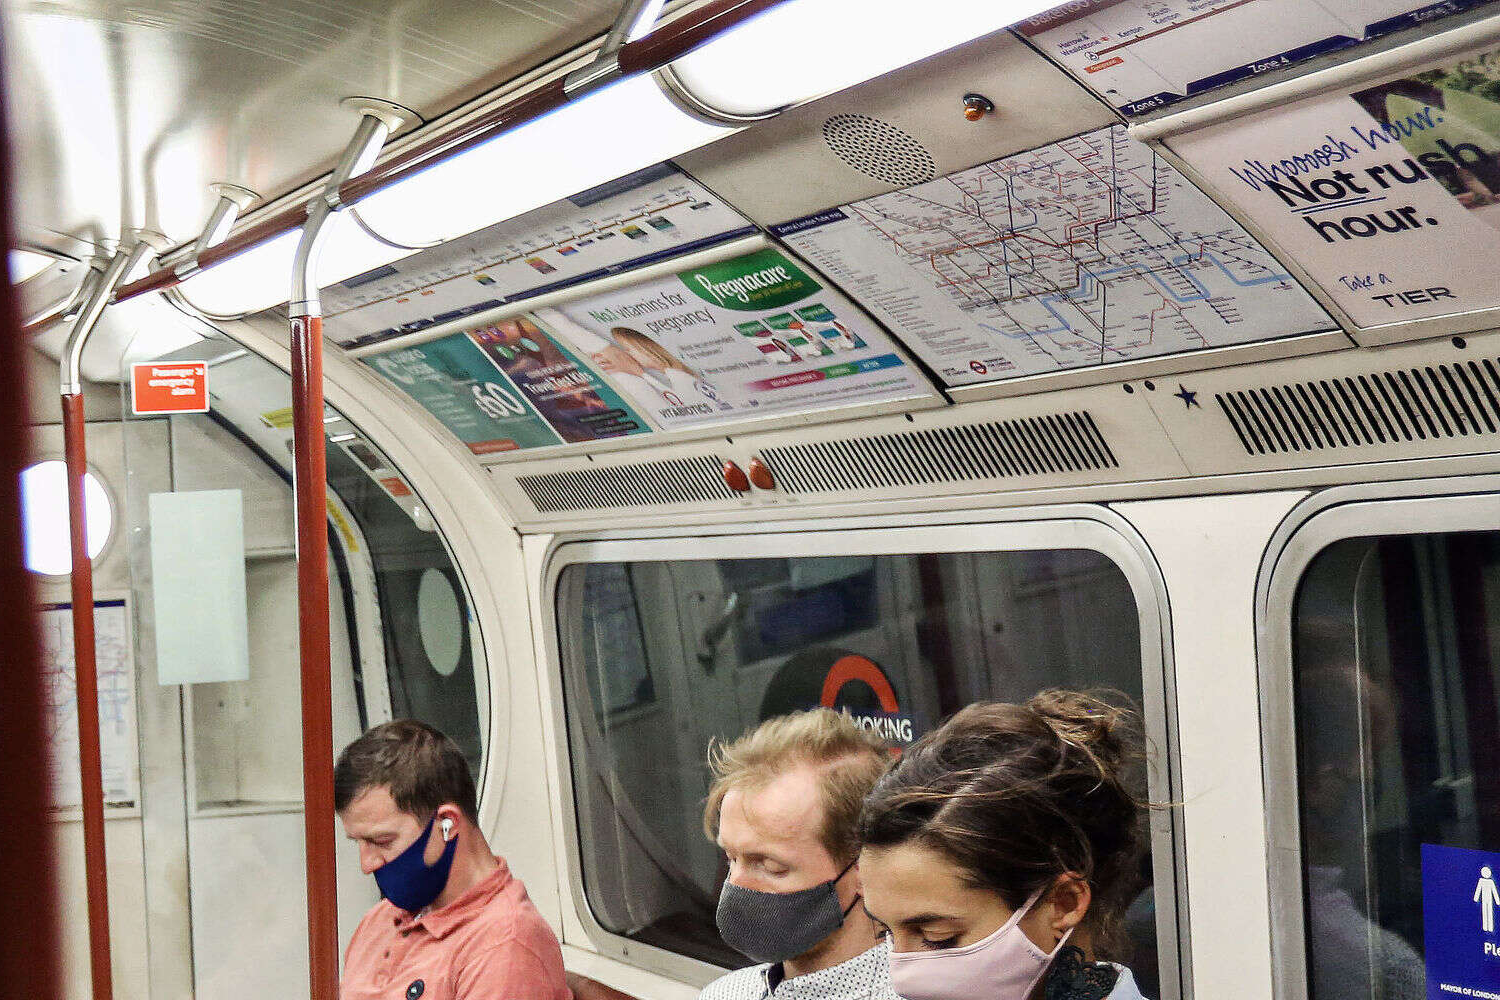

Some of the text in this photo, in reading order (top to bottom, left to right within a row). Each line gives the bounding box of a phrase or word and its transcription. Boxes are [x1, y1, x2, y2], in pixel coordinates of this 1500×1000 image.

[1058, 37, 1083, 48] Harrow
[1117, 26, 1145, 38] Kenton
[1060, 39, 1101, 55] Wealdstone
[1248, 56, 1290, 74] Zone 4
[1127, 96, 1164, 114] Zone 5
[1350, 106, 1445, 150] hour.
[1264, 138, 1489, 207] Not rush
[1303, 205, 1438, 243] hour.
[695, 264, 791, 307] Pregnacare
[1339, 272, 1393, 292] Take a
[614, 296, 670, 321] vitamins
[660, 290, 688, 311] for
[1372, 286, 1459, 308] TIER
[645, 307, 717, 337] pregnancy
[659, 402, 714, 418] VITABIOTICS
[850, 714, 913, 743] MOKING
[1440, 983, 1463, 996] MAYOR
[1463, 987, 1472, 997] OF
